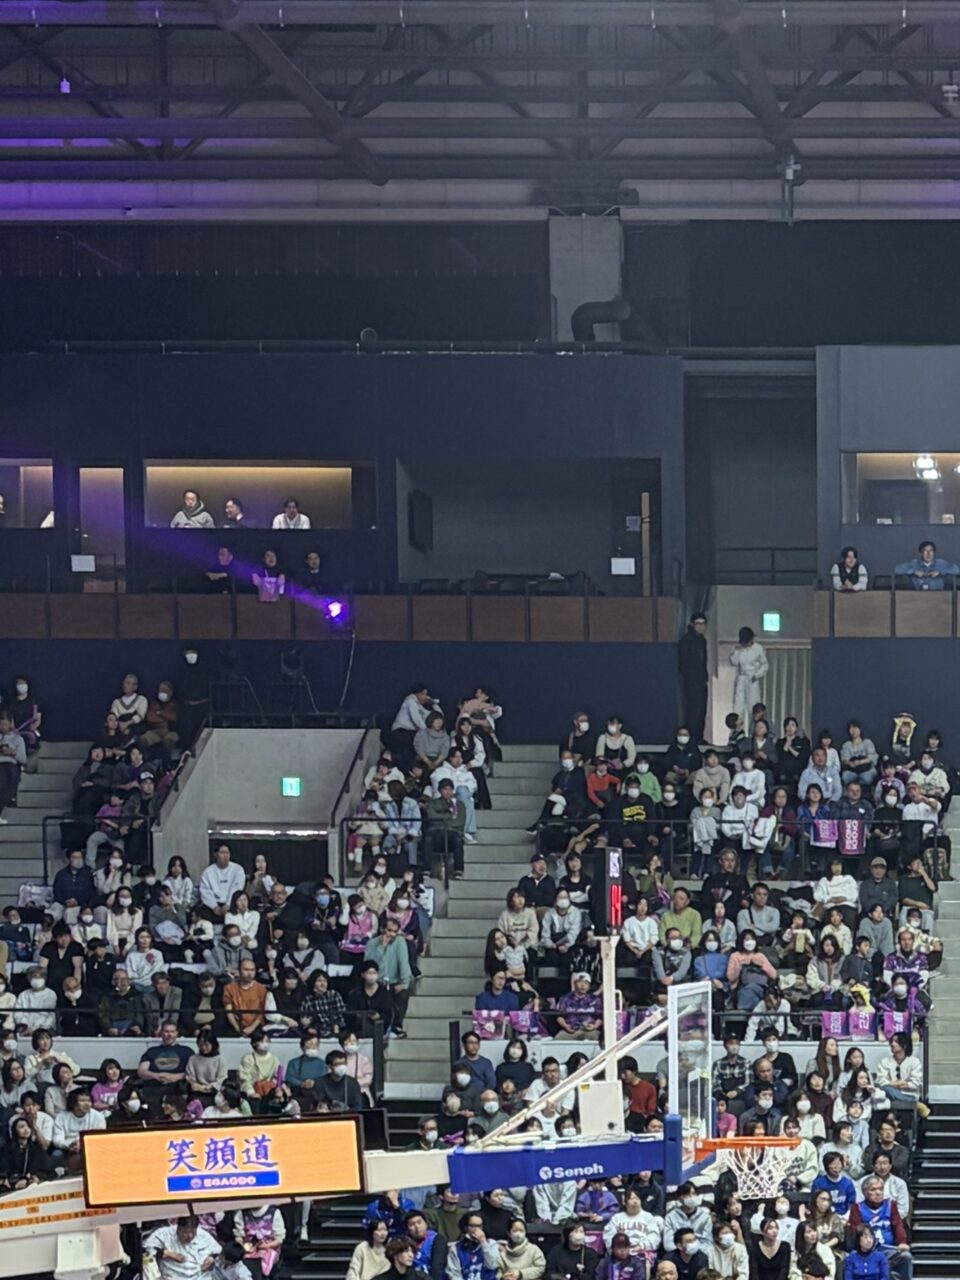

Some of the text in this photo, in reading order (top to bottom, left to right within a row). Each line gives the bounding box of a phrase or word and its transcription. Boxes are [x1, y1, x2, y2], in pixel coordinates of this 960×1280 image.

[168, 1134, 279, 1172] 笑顔道
[554, 1163, 603, 1179] Senoh
